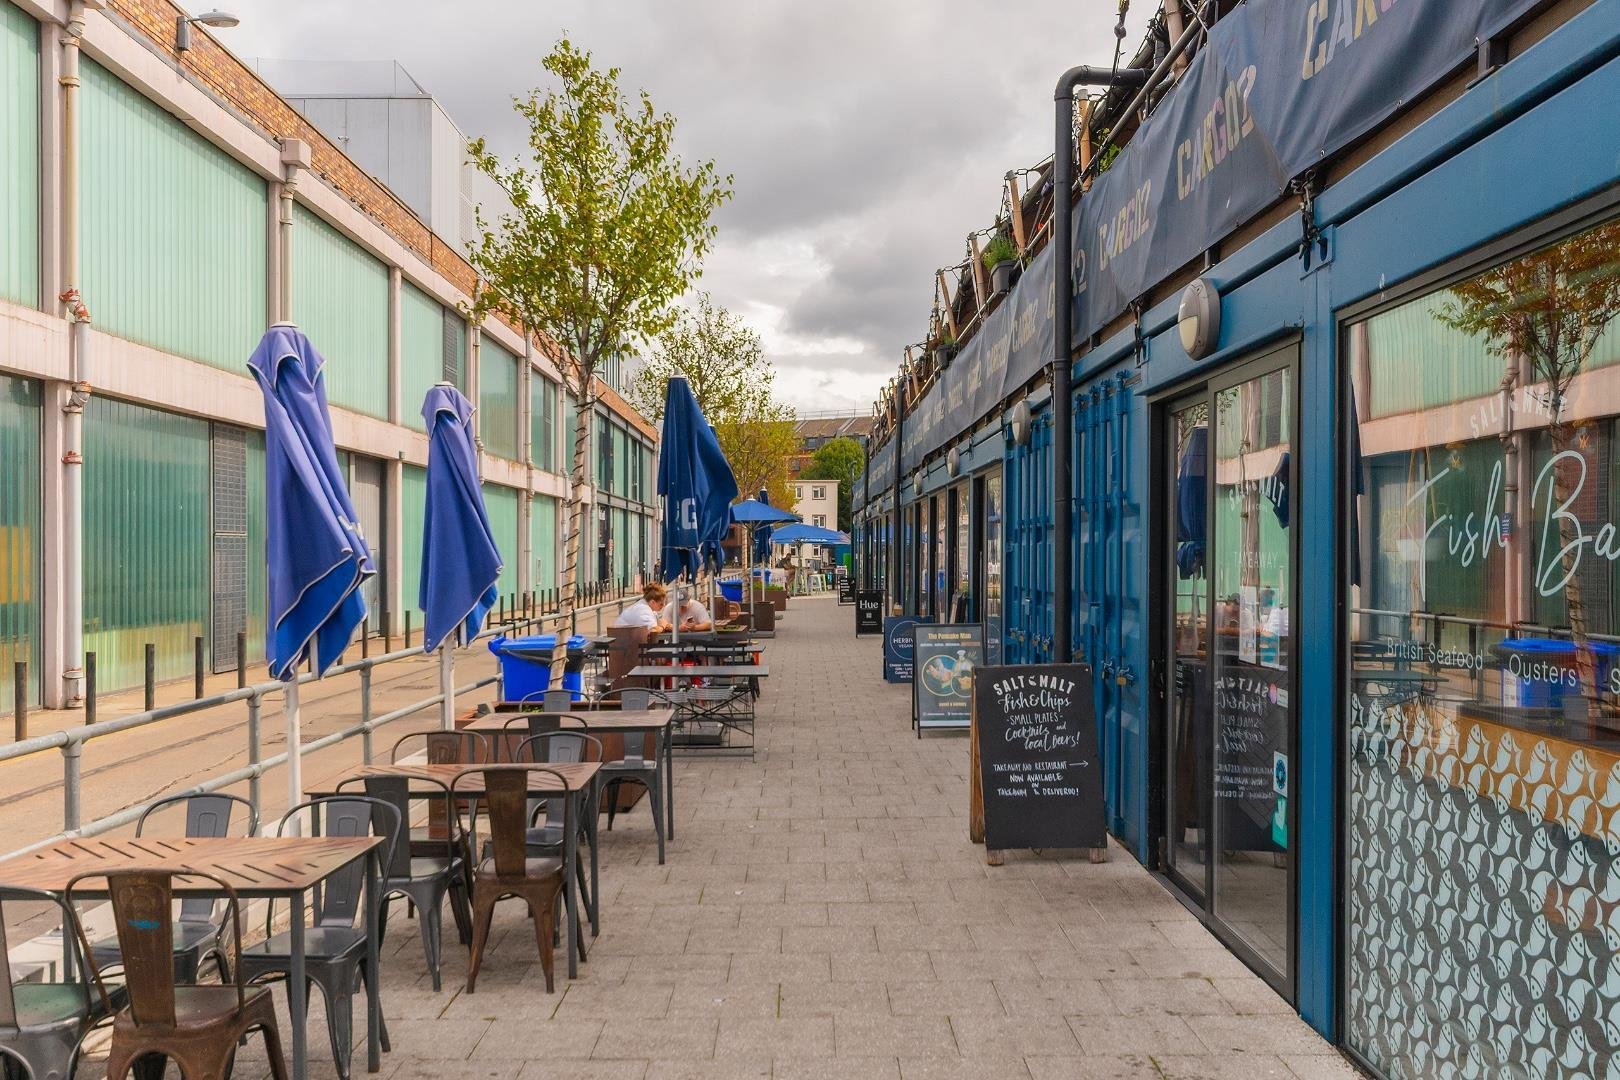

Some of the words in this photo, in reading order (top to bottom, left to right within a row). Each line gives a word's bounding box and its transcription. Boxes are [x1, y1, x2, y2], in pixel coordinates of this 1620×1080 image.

[1177, 64, 1256, 200] CARGO2
[1099, 178, 1151, 272] CARGO2
[1406, 460, 1506, 602] Fish
[860, 600, 879, 609] Hue
[1387, 637, 1423, 661] British
[1428, 643, 1483, 671] Seafood
[1509, 653, 1576, 687] Oysters
[993, 676, 1025, 696] SALT
[1039, 675, 1075, 694] MALT
[1005, 724, 1050, 742] Cocktails
[1056, 721, 1067, 731] and
[993, 762, 1021, 772] TAKEAWAY
[1022, 762, 1033, 772] AND
[1034, 760, 1068, 771] RESTAURANT
[1010, 773, 1024, 783] NOW
[1026, 771, 1064, 782] AVAILABLE
